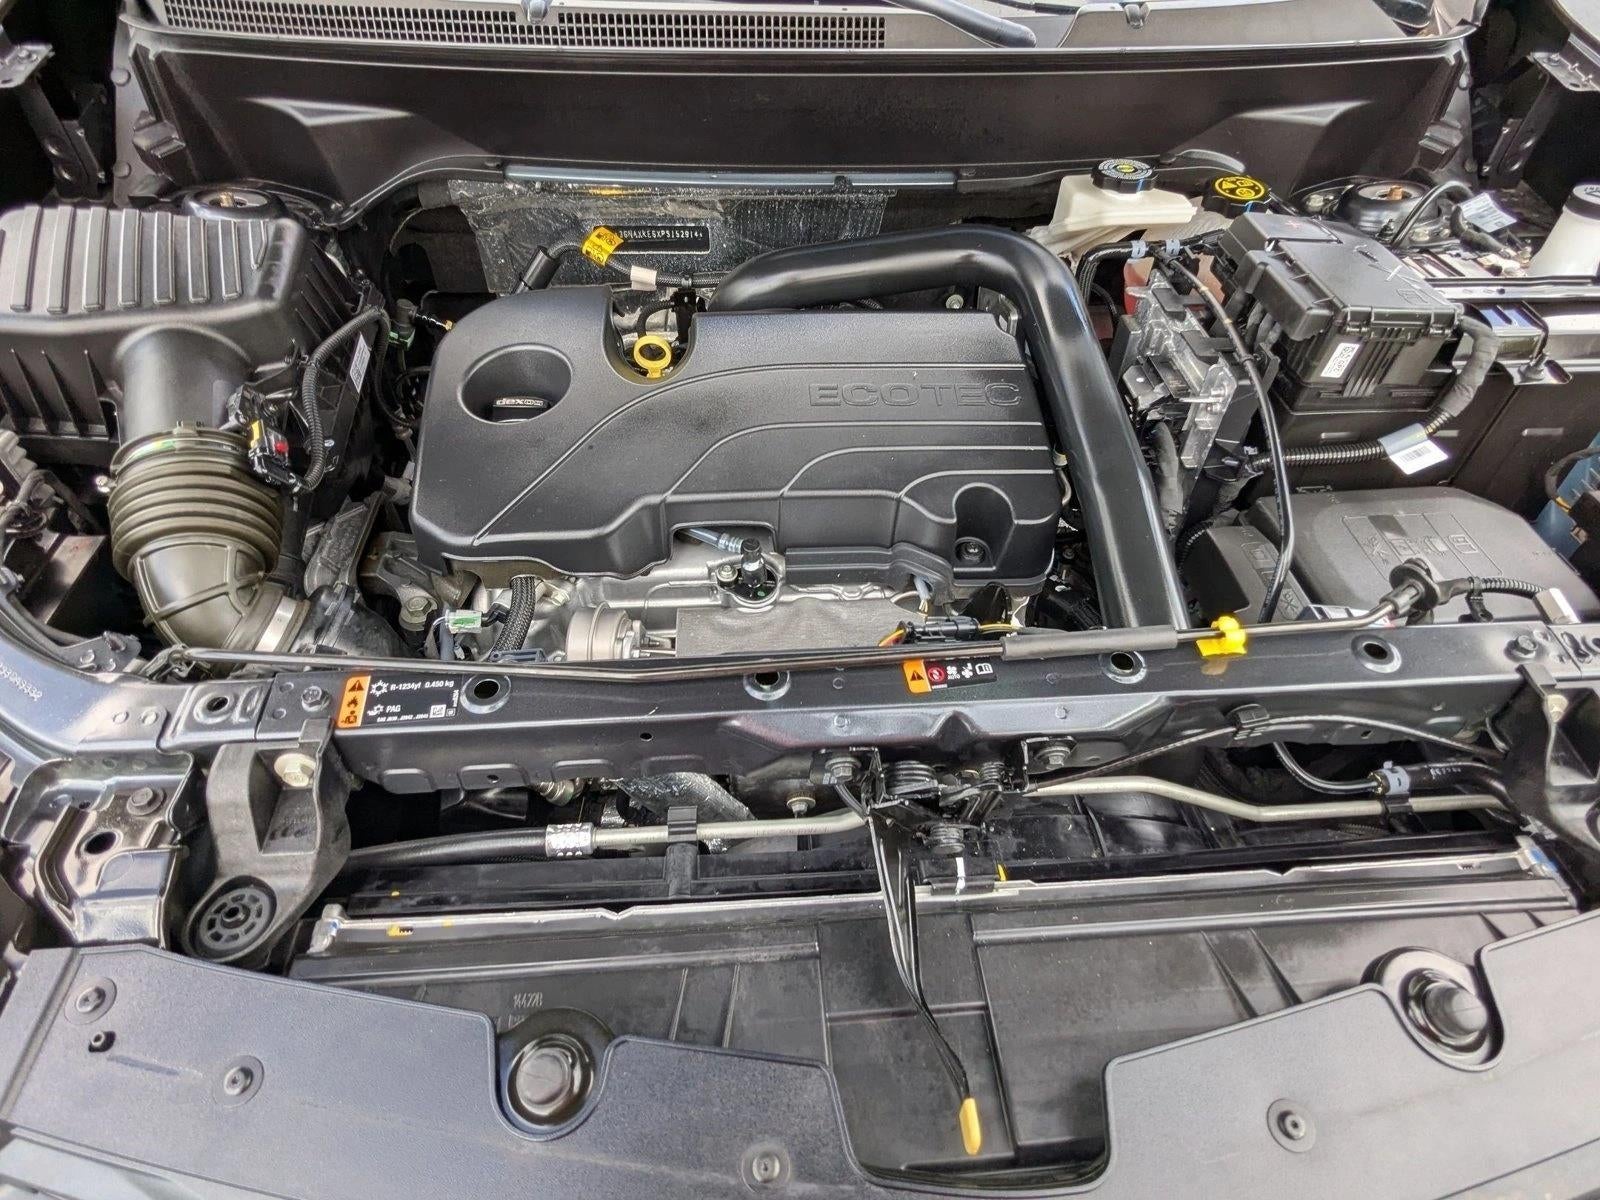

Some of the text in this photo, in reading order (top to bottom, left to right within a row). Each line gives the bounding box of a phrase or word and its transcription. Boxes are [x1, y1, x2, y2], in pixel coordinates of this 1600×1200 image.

[809, 382, 1023, 407] ECOTEC
[390, 680, 455, 691] R-1234yf 0.450 kg
[385, 704, 402, 714] PAG
